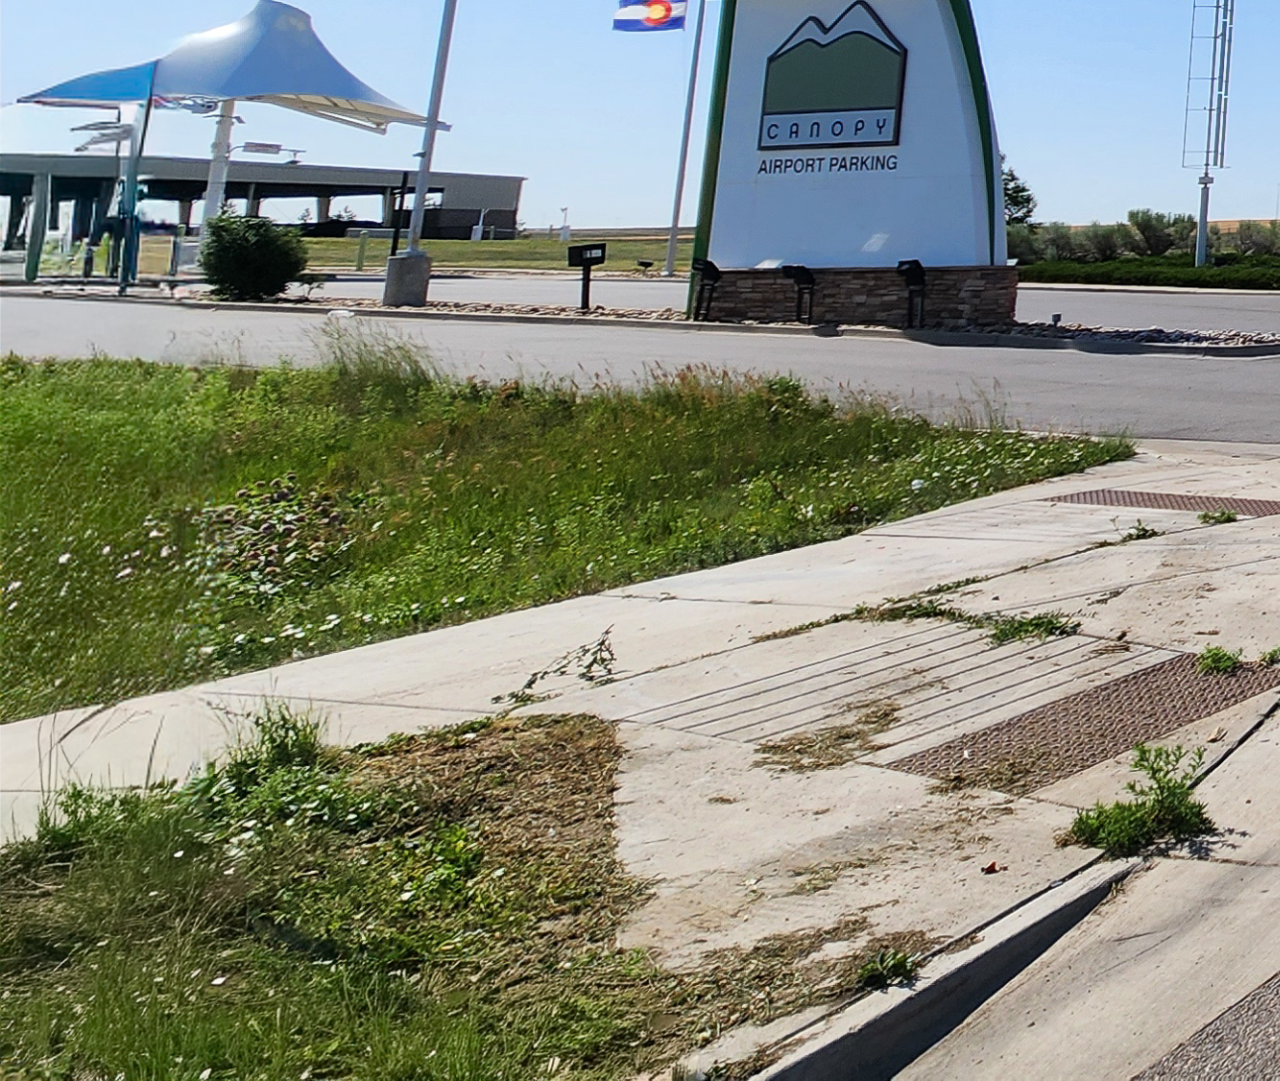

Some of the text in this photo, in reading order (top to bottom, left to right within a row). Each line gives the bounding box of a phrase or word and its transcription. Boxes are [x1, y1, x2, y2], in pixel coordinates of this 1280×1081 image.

[766, 118, 887, 140] CANOPY
[757, 154, 898, 175] AIRPORT PARKING
